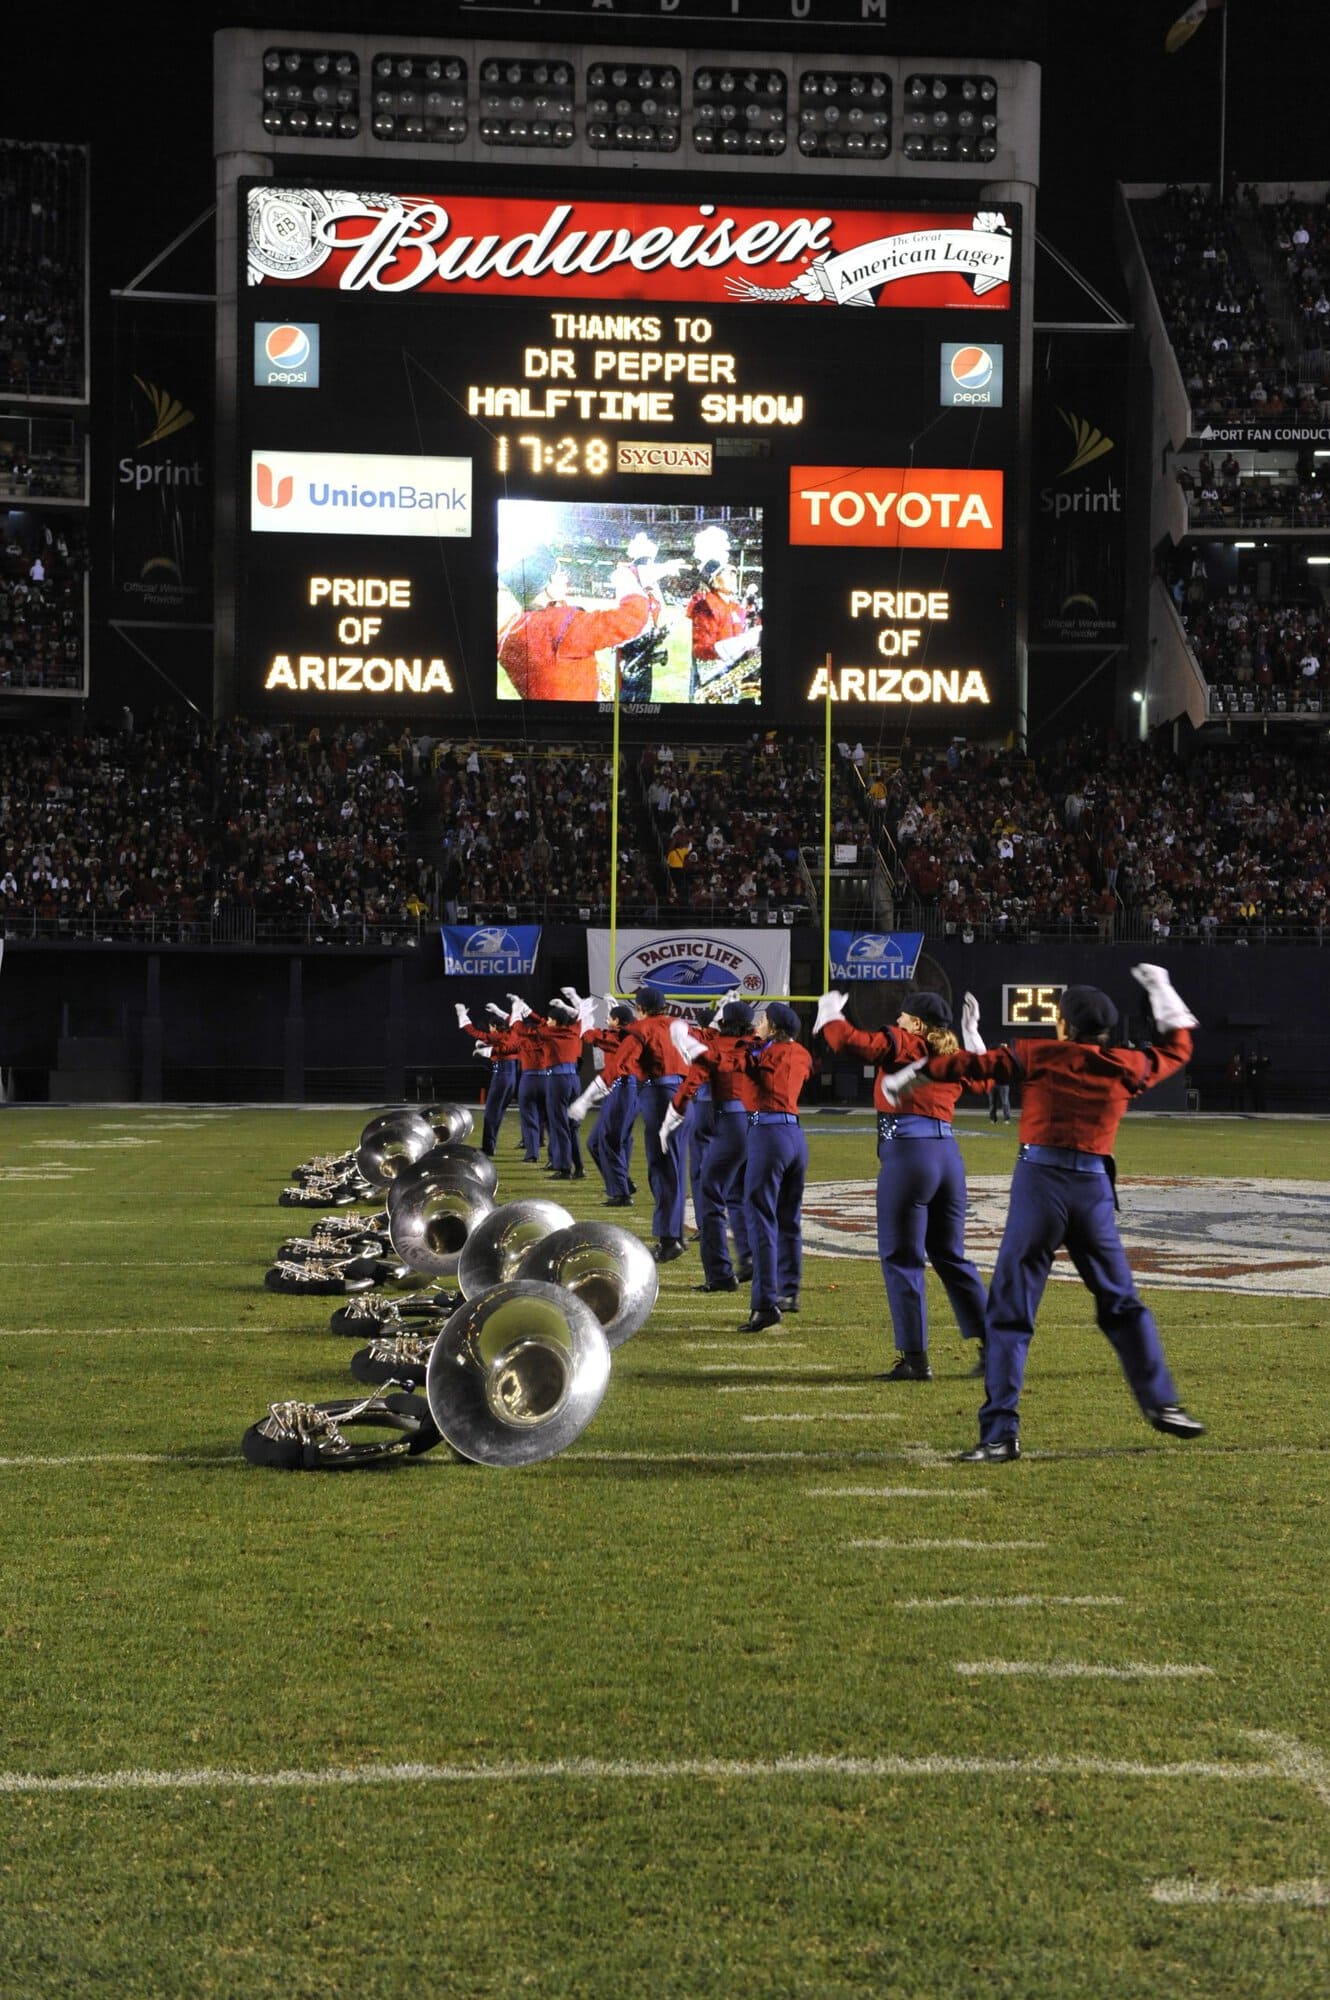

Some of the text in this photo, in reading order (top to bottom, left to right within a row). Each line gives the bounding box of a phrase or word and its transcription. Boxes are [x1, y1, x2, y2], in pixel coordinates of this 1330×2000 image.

[322, 203, 833, 291] Budweiser
[892, 232, 943, 247] The Great
[838, 242, 1006, 290] American Lager
[551, 313, 712, 343] THANKS TO
[267, 371, 308, 385] pepsi
[524, 347, 737, 384] DR PEPPER
[467, 385, 804, 425] HALFTIME SHOW
[952, 391, 992, 405] pepsi
[1247, 428, 1272, 441] FAN
[498, 435, 609, 475] 17:28
[619, 448, 711, 467] SYCUAN
[118, 457, 204, 491] Sprint
[308, 482, 467, 511] UnionBank
[800, 490, 994, 529] TOYOTA
[1039, 486, 1122, 519] Sprint
[309, 577, 412, 609] PRIDE
[851, 590, 950, 620] PRIDE
[337, 616, 383, 646] OF
[877, 629, 922, 657] OF
[264, 654, 454, 694] ARIZONA
[807, 667, 991, 704] ARIZONA
[630, 703, 662, 715] VISION
[444, 957, 533, 975] PACIFIC LIF
[635, 942, 744, 970] PACIFIC LIFE
[1012, 987, 1058, 1022] 25
